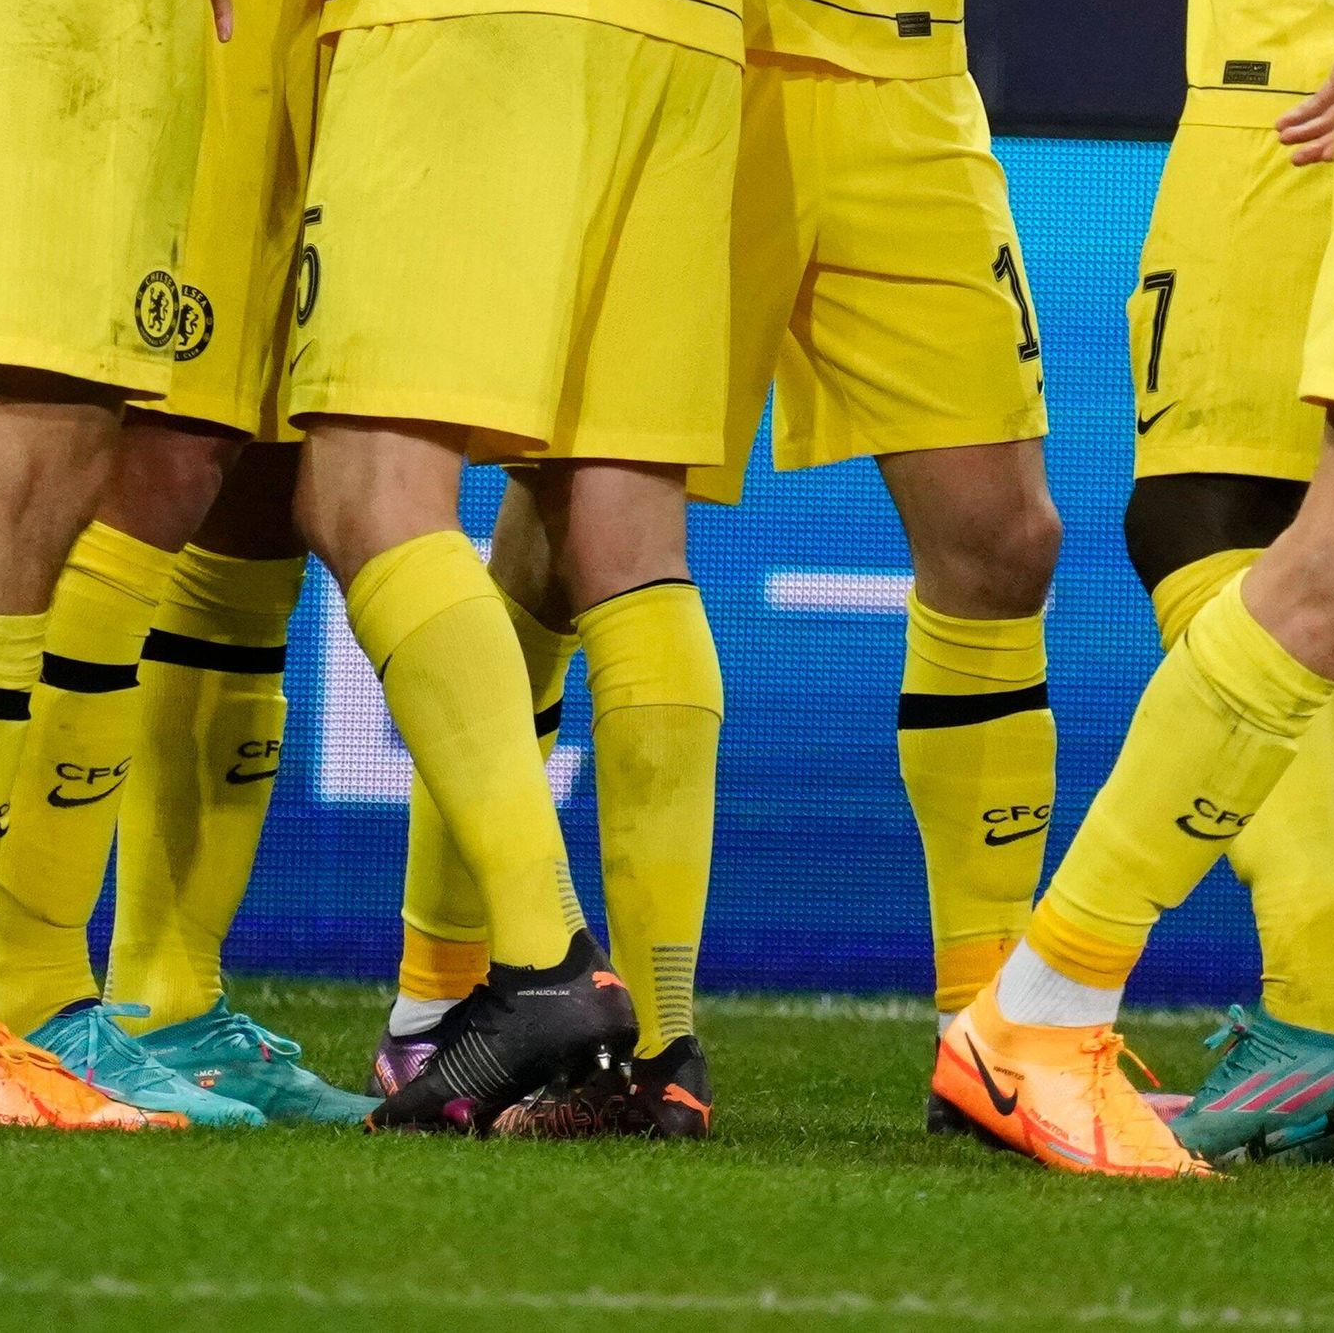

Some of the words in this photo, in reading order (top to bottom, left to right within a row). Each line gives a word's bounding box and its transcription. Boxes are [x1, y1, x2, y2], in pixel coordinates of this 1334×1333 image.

[145, 272, 175, 293] CHELSEA
[184, 286, 207, 307] LSEA
[1142, 269, 1177, 394] 7
[238, 740, 283, 758] CF
[982, 804, 1050, 824] CFC
